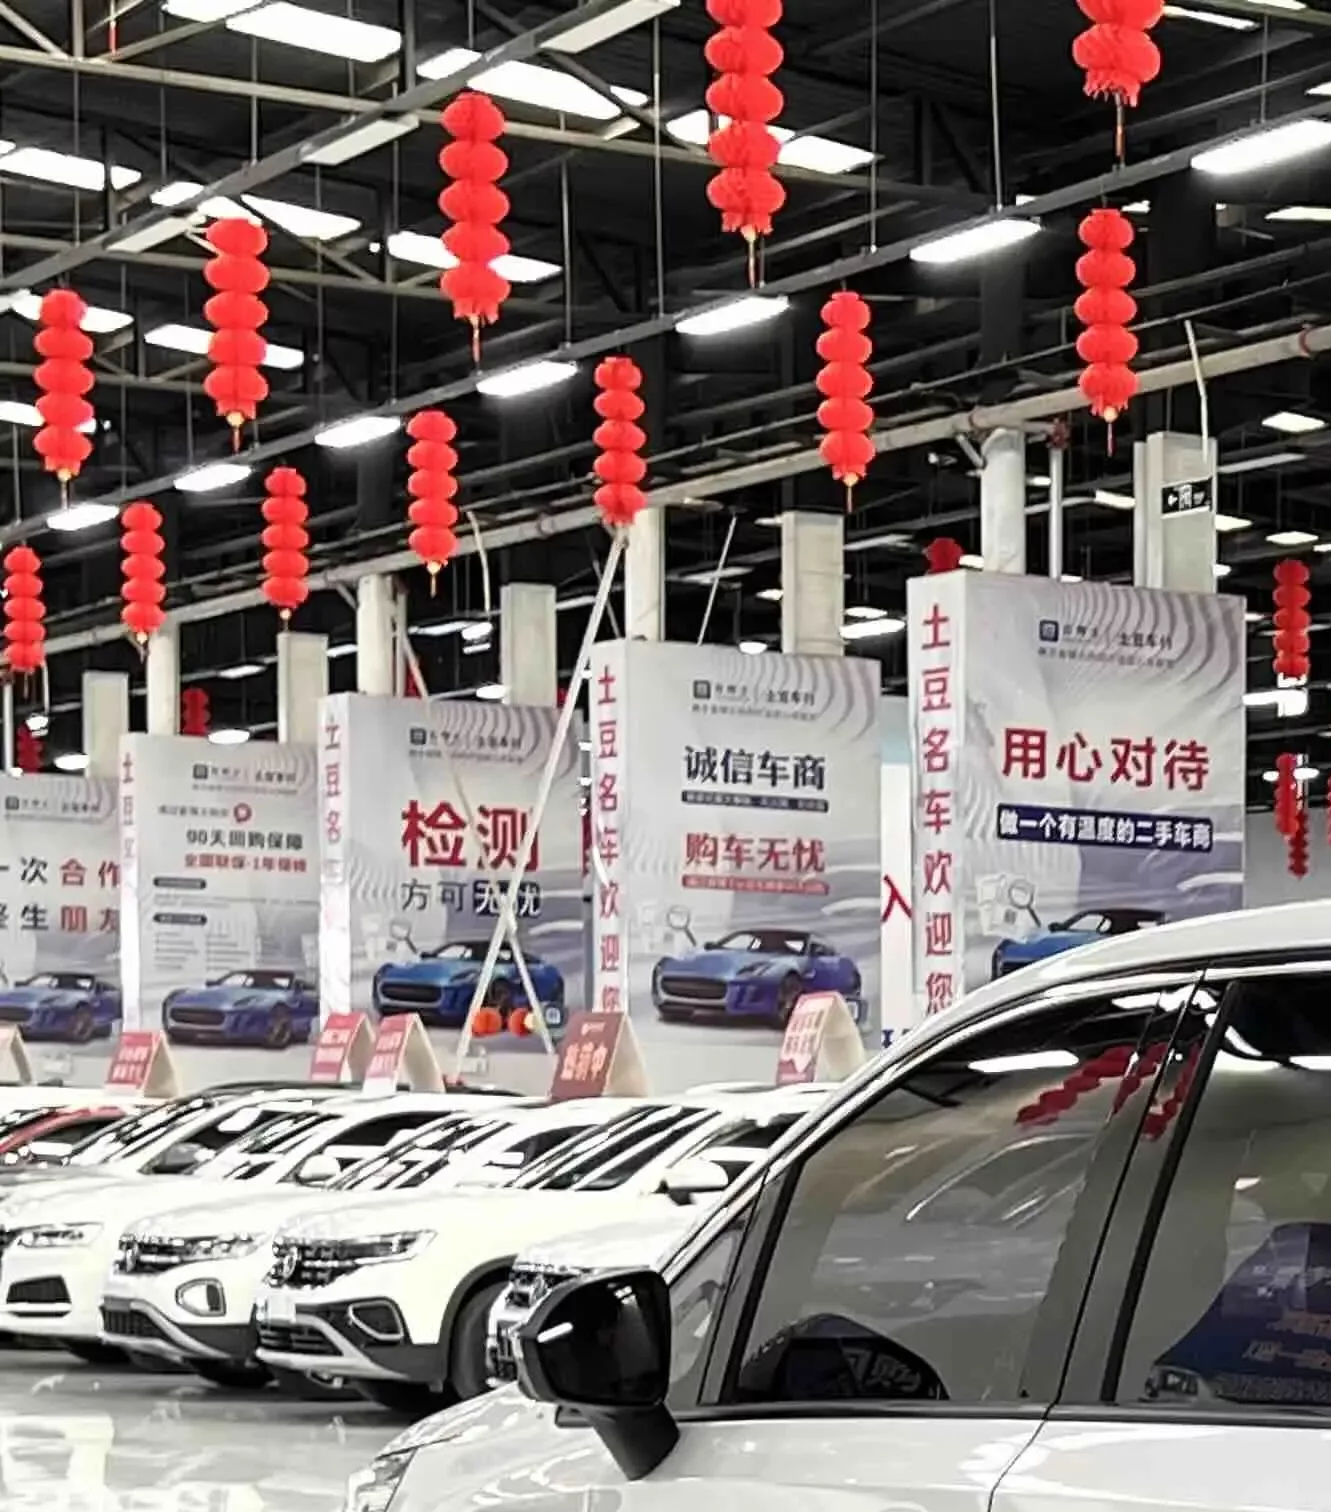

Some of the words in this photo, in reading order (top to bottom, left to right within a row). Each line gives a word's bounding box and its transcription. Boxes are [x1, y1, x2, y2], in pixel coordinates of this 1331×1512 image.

[684, 745, 826, 791] 诚信车商
[1002, 727, 1209, 791] 用心对待
[401, 799, 540, 872] 检测
[921, 605, 954, 1015] 土豆名车欢迎您
[1000, 809, 1212, 850] 做一个有温度的二手车商
[685, 832, 826, 873] 购车无忧
